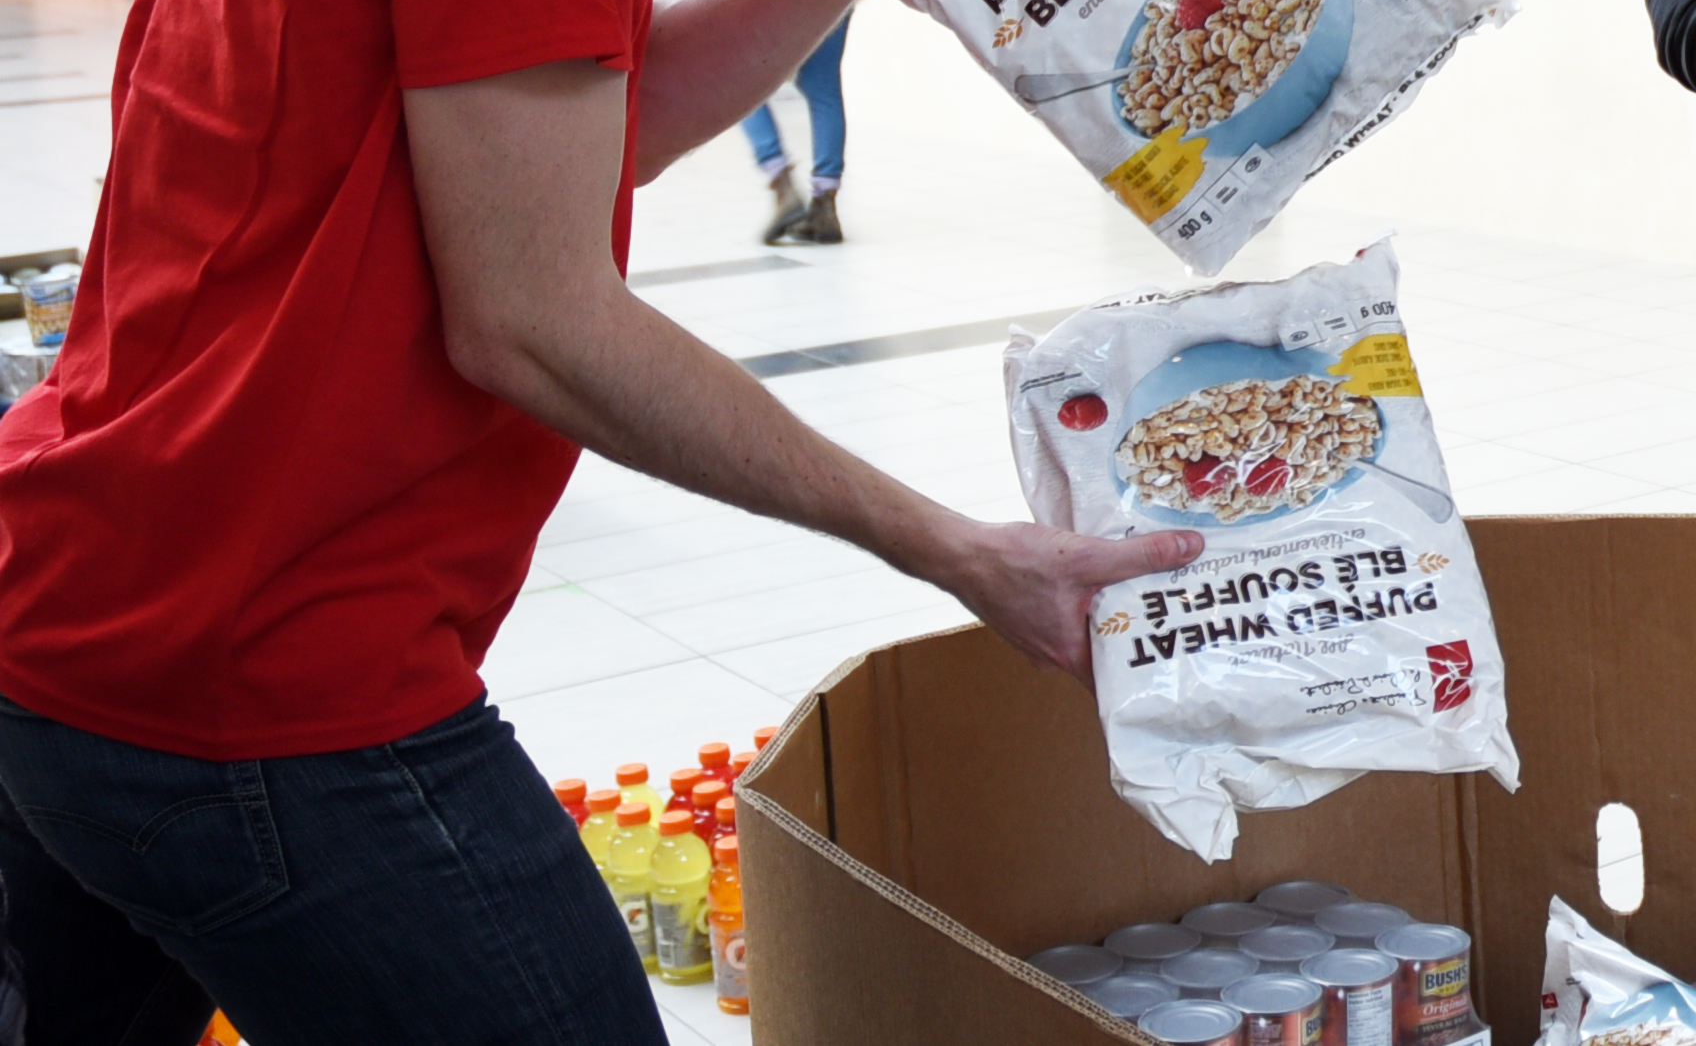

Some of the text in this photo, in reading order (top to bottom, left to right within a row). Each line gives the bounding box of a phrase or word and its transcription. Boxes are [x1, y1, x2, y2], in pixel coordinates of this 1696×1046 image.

[1343, 102, 1393, 149] WHEAT
[1177, 210, 1213, 241] 400 g
[1372, 300, 1396, 316] 400
[1169, 528, 1366, 585] entièrement naturel
[1139, 545, 1408, 630] BLÉ SOUFFLÉ
[1127, 581, 1438, 669] PUFFED WHEAT
[1318, 633, 1355, 654] All
